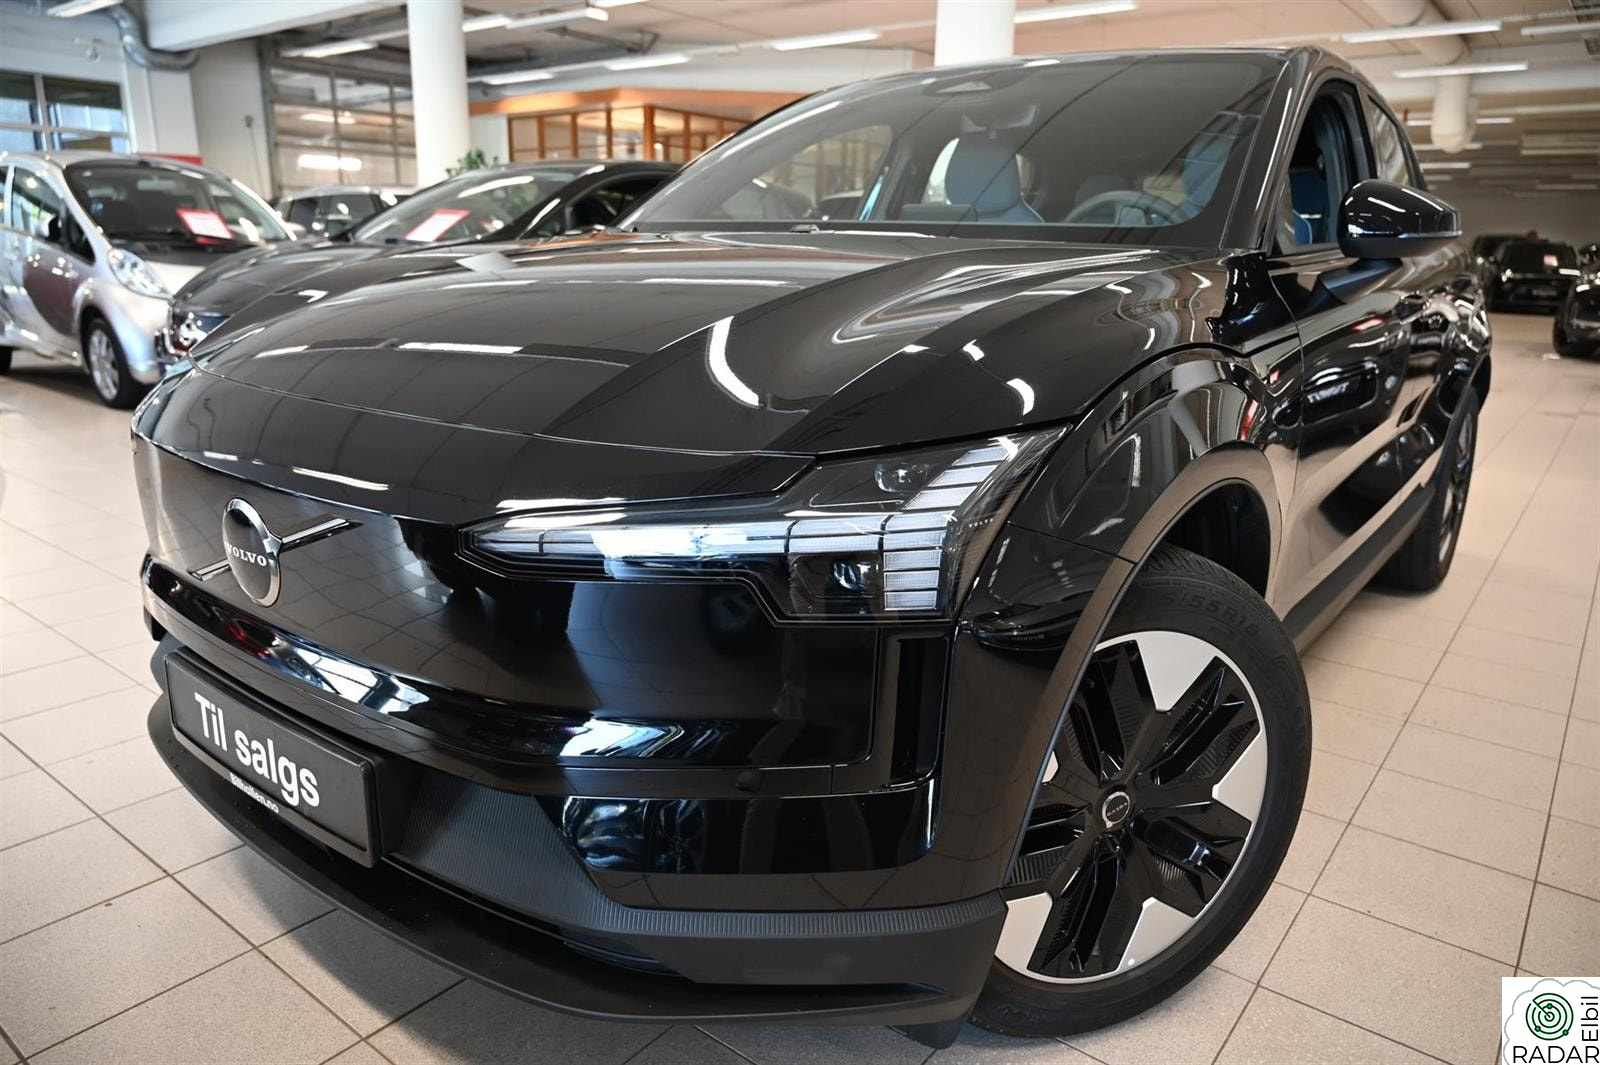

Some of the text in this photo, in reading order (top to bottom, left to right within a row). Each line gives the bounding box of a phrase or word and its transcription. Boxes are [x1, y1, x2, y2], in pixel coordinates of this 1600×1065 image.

[224, 541, 268, 567] VOLVO
[194, 691, 320, 807] Til salgs
